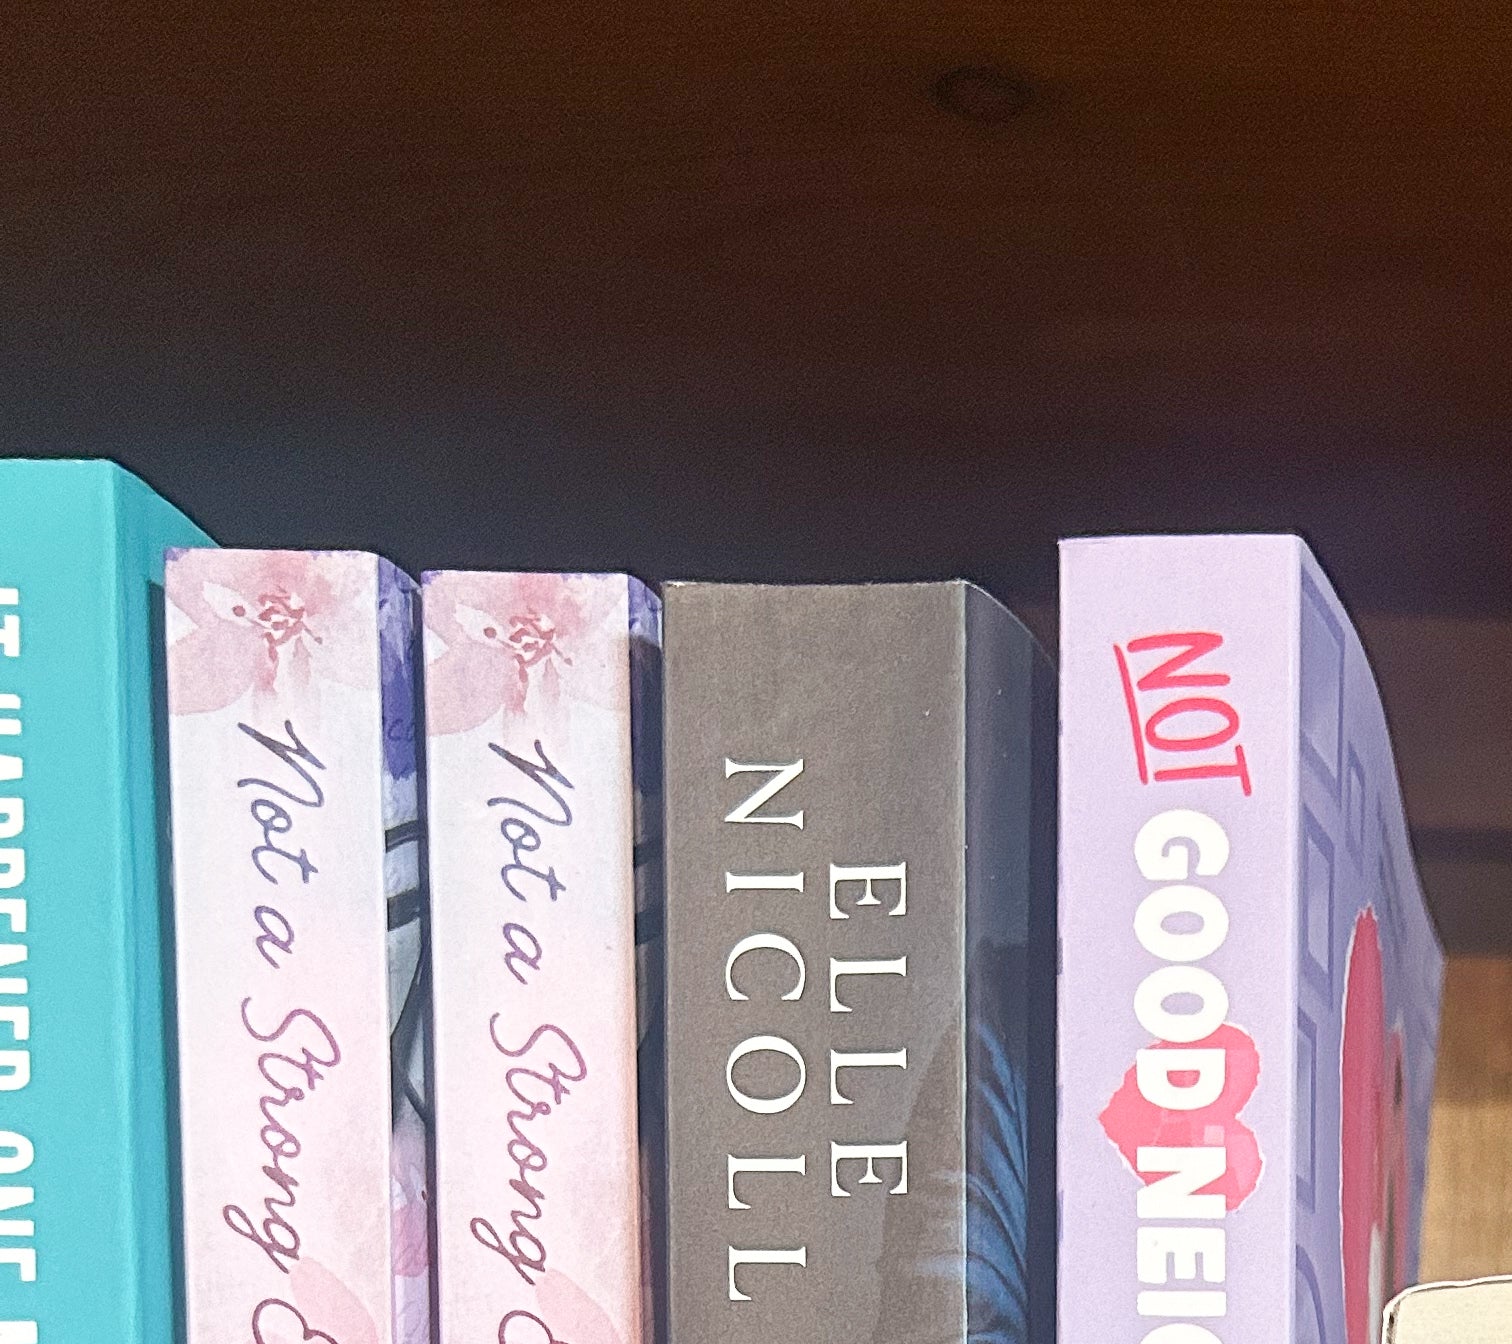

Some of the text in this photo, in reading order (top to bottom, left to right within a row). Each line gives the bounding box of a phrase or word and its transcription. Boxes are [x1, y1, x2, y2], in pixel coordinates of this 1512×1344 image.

[235, 719, 328, 887] Not
[488, 738, 574, 904] Not
[1126, 631, 1252, 798] NOT
[254, 905, 294, 971] a
[503, 923, 544, 985] a
[724, 757, 807, 1302] NICOLL
[829, 861, 908, 1198] ELLE
[1133, 808, 1230, 1111] GOOD
[223, 995, 341, 1274] Strong
[470, 1012, 588, 1285] Strong
